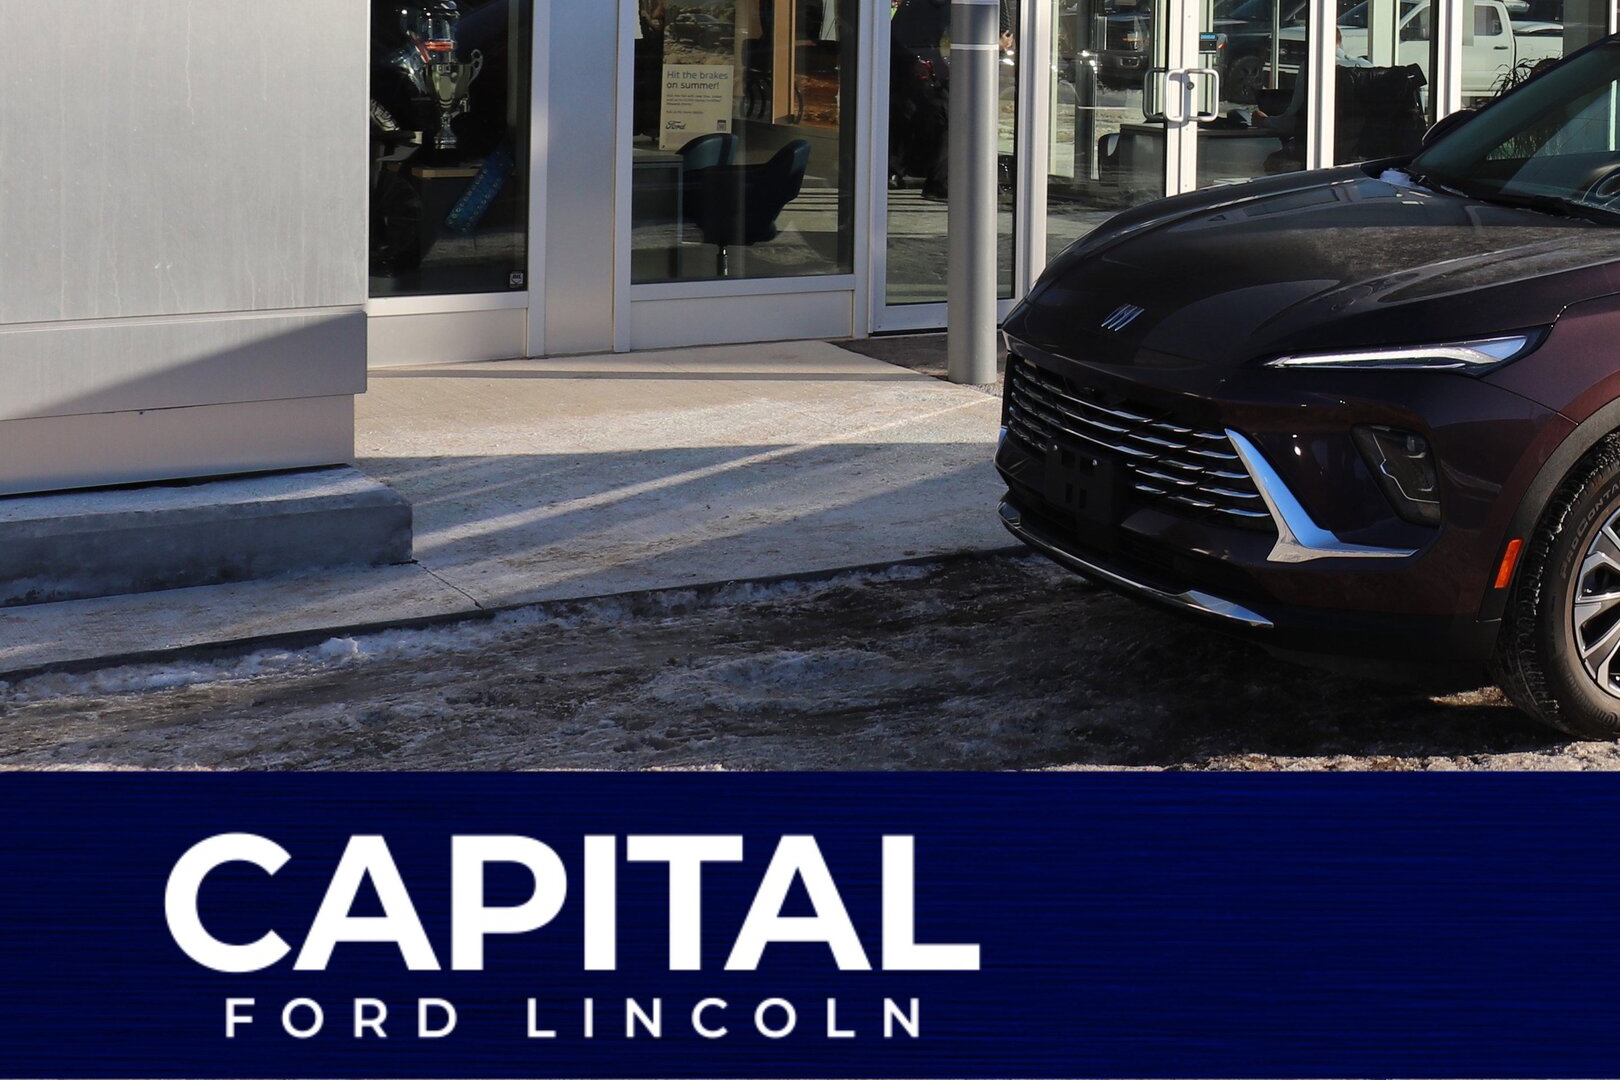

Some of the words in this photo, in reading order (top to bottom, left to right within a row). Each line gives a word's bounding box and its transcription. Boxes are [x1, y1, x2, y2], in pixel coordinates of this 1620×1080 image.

[666, 71, 680, 80] Hit
[682, 71, 697, 80] the
[699, 71, 729, 80] brakes
[680, 82, 720, 90] summer!
[665, 120, 687, 130] Ford
